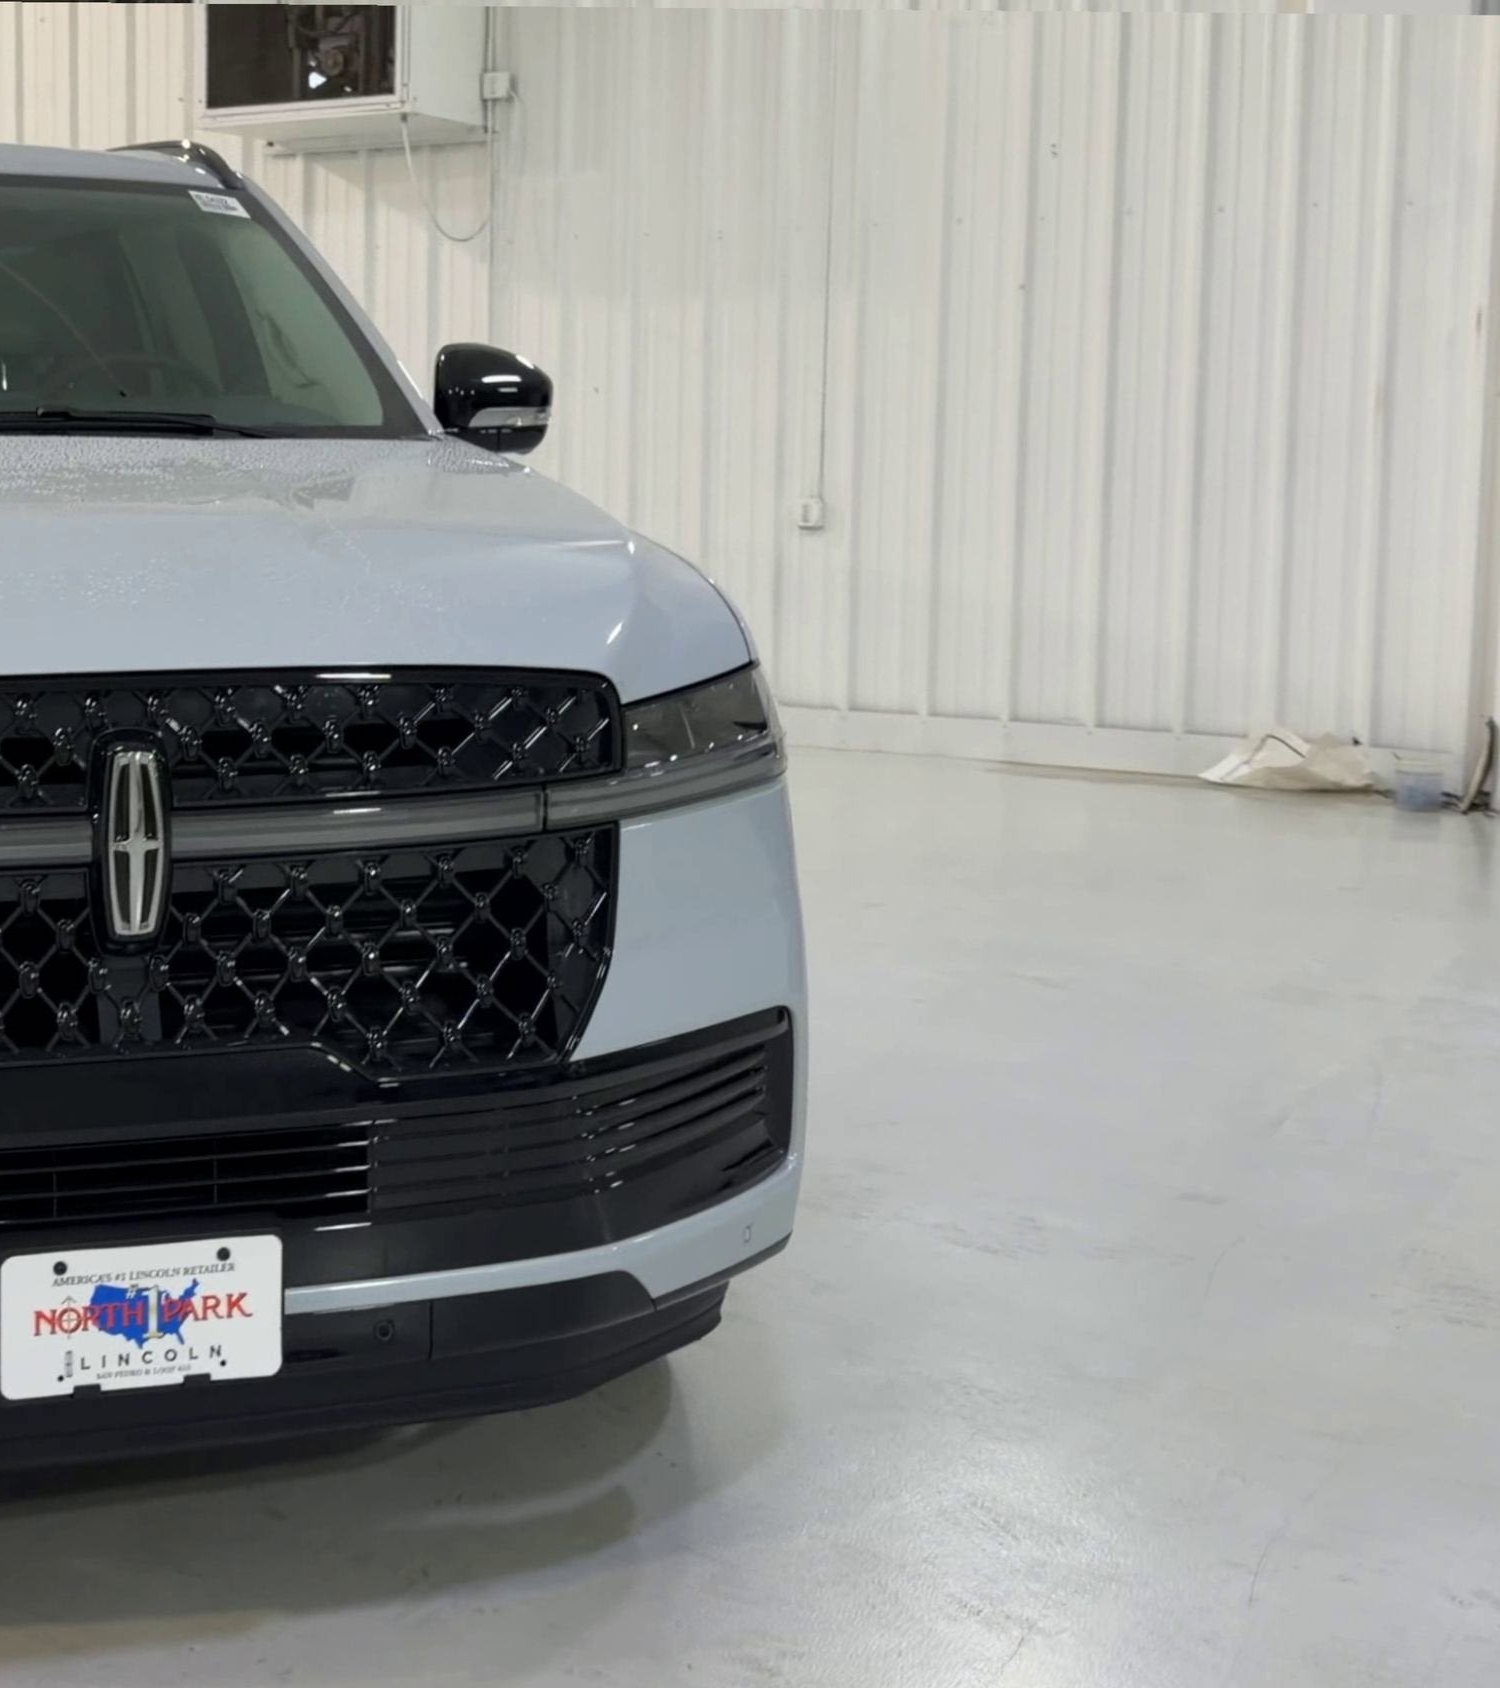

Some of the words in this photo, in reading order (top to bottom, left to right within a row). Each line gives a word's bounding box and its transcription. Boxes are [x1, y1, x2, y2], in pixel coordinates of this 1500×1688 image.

[52, 1271, 112, 1287] AMERICA'S
[129, 1266, 181, 1281] LINCOLN
[182, 1262, 235, 1277] RETAILER
[33, 1301, 144, 1337] NORTH
[162, 1292, 253, 1323] PARK
[80, 1344, 222, 1371] LINCOLN
